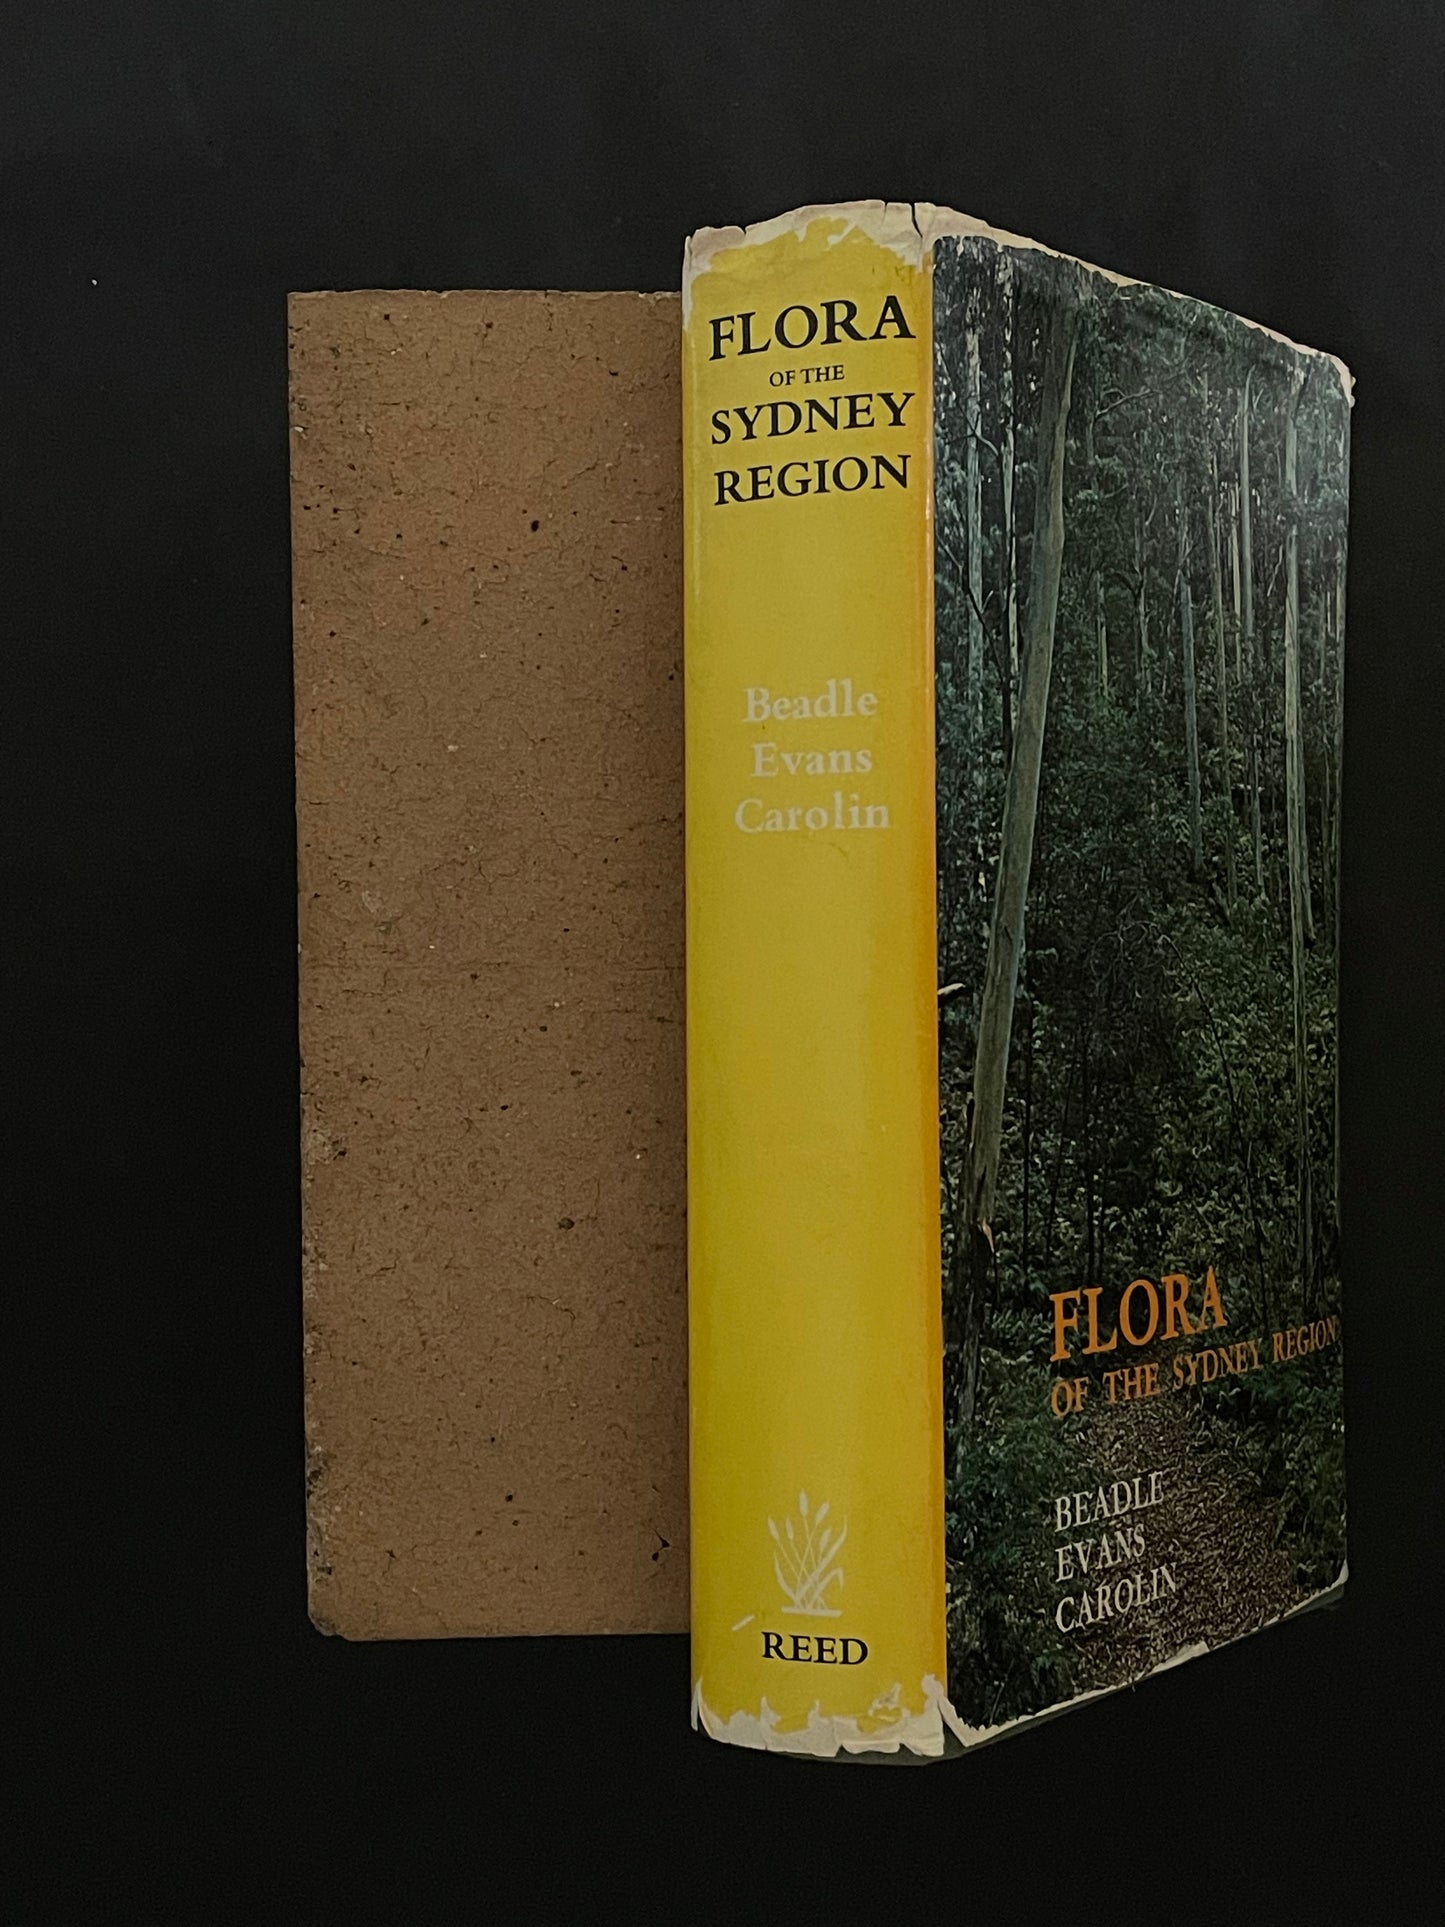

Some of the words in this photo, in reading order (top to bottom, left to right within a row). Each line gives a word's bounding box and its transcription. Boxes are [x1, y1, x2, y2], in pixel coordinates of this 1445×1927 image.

[709, 295, 916, 361] FLORA
[769, 370, 796, 387] OF
[800, 364, 845, 384] THE
[711, 392, 915, 445] SYDNEY
[713, 454, 911, 506] REGION
[743, 678, 878, 723] Beadle
[751, 742, 873, 778] Evans
[735, 791, 891, 834] Carolin
[1049, 1265, 1228, 1362] FLORA
[1050, 1377, 1089, 1420] OF
[1103, 1363, 1162, 1405] THE
[1172, 1338, 1263, 1392] SYDNEY
[1272, 1315, 1338, 1364] REGION
[1054, 1471, 1165, 1533] BEADLE
[1055, 1523, 1146, 1583] EVANS
[1055, 1562, 1177, 1634] CAROLIN
[761, 1631, 869, 1666] REED
